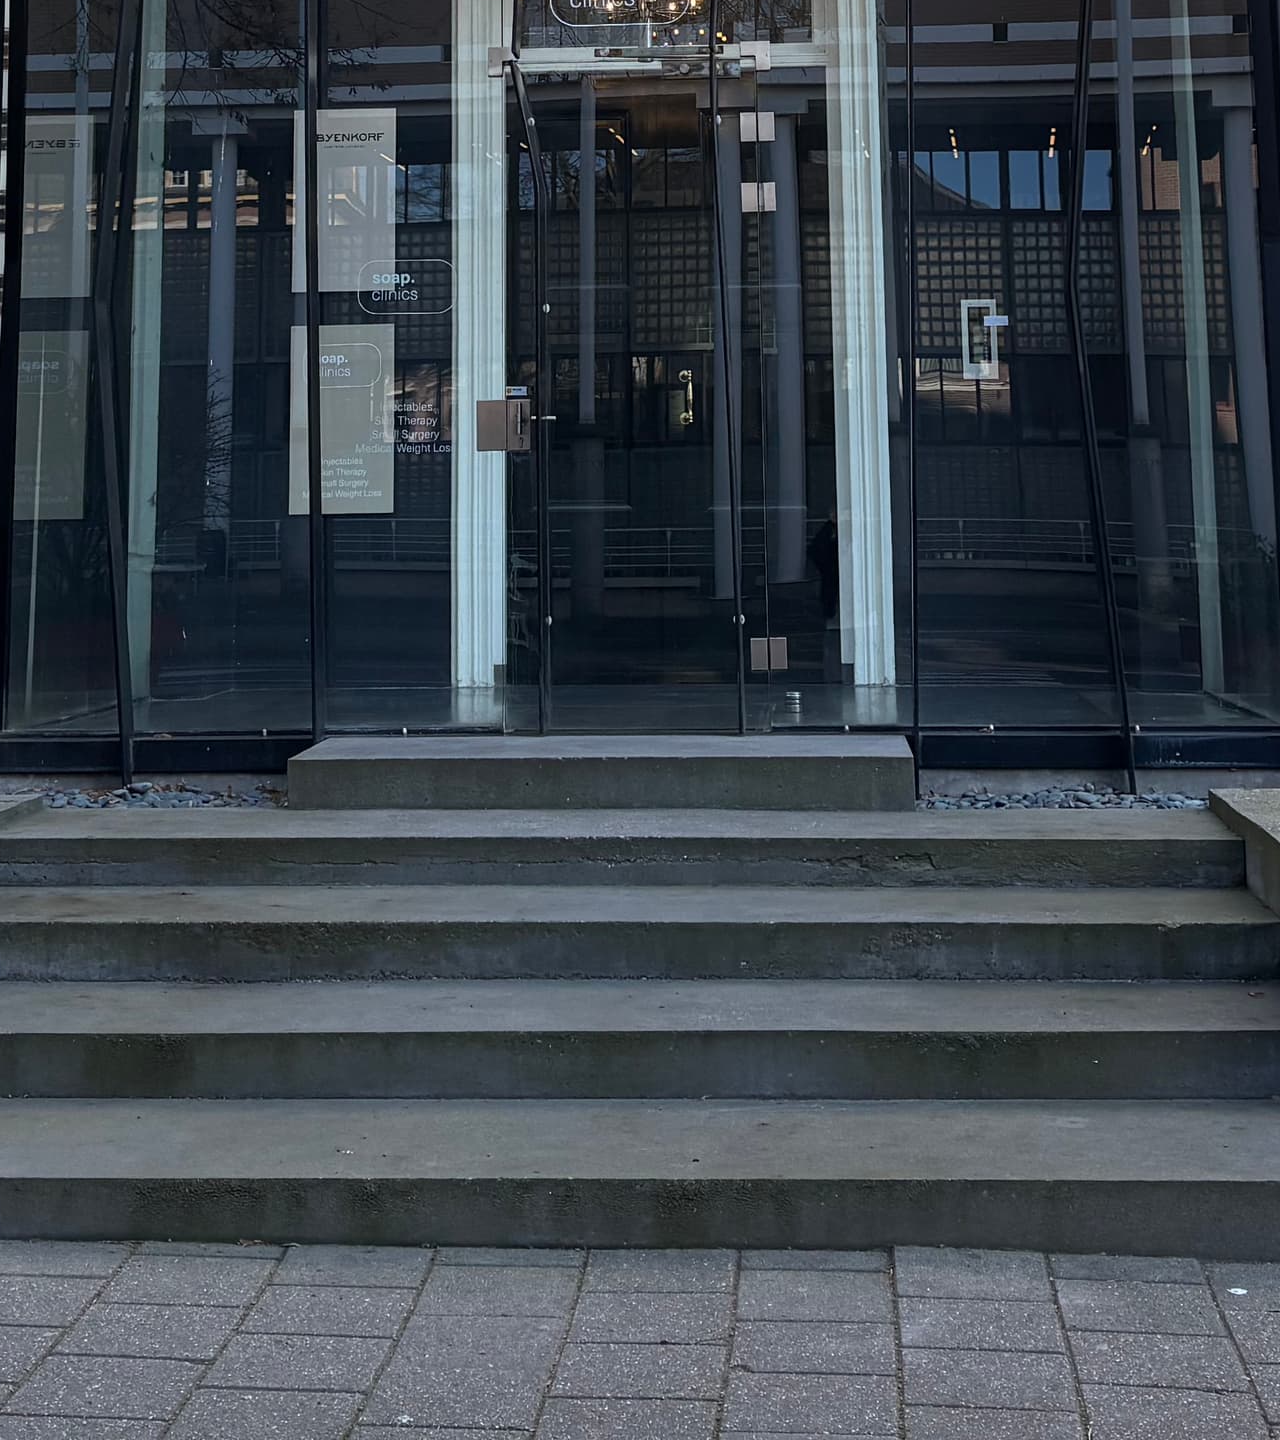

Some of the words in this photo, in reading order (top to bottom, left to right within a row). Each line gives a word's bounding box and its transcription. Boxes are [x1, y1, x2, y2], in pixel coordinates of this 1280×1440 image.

[372, 272, 415, 286] soap.
[371, 287, 418, 301] clinics
[321, 353, 349, 366] oap.
[321, 366, 351, 377] linics
[380, 402, 433, 413] Iectables
[398, 416, 438, 427] Therapy
[372, 429, 399, 439] Smll
[401, 429, 440, 441] Surgery
[397, 443, 431, 455] Weight
